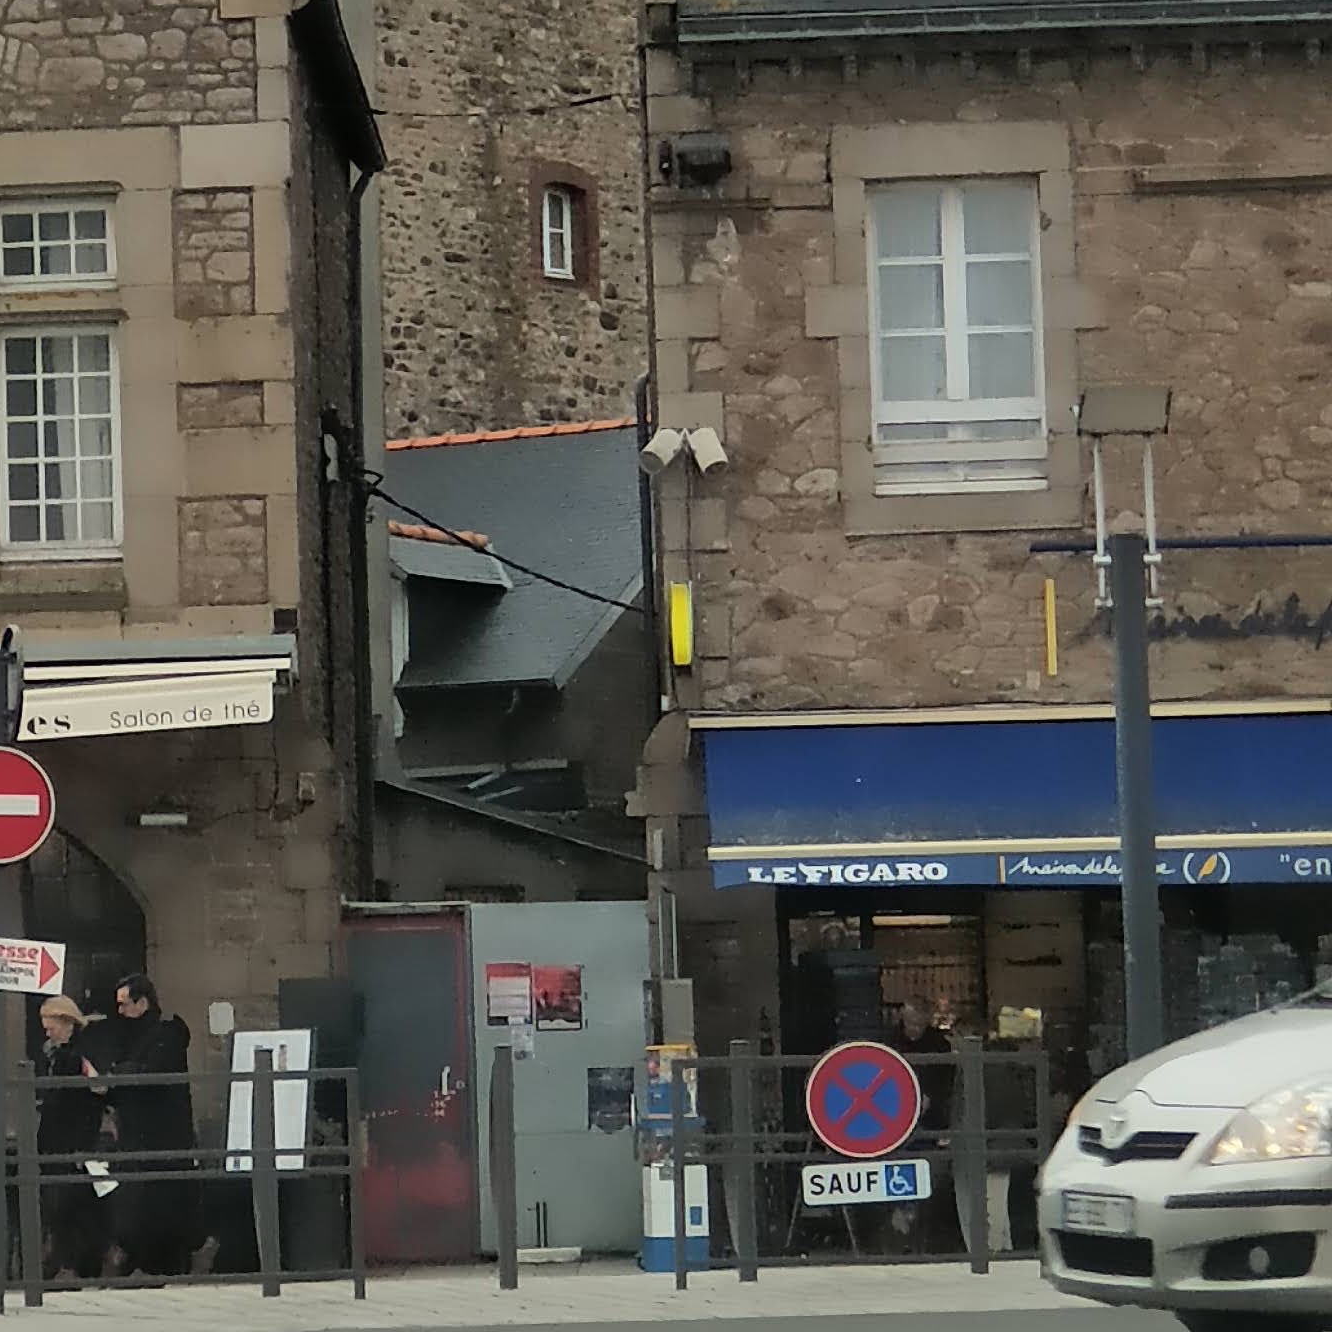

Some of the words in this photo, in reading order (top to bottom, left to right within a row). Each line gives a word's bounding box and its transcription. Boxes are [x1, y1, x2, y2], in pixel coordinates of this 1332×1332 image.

[109, 710, 173, 730] Salon
[182, 704, 213, 723] de
[224, 699, 261, 720] thé
[809, 1170, 879, 1196] SAUF
